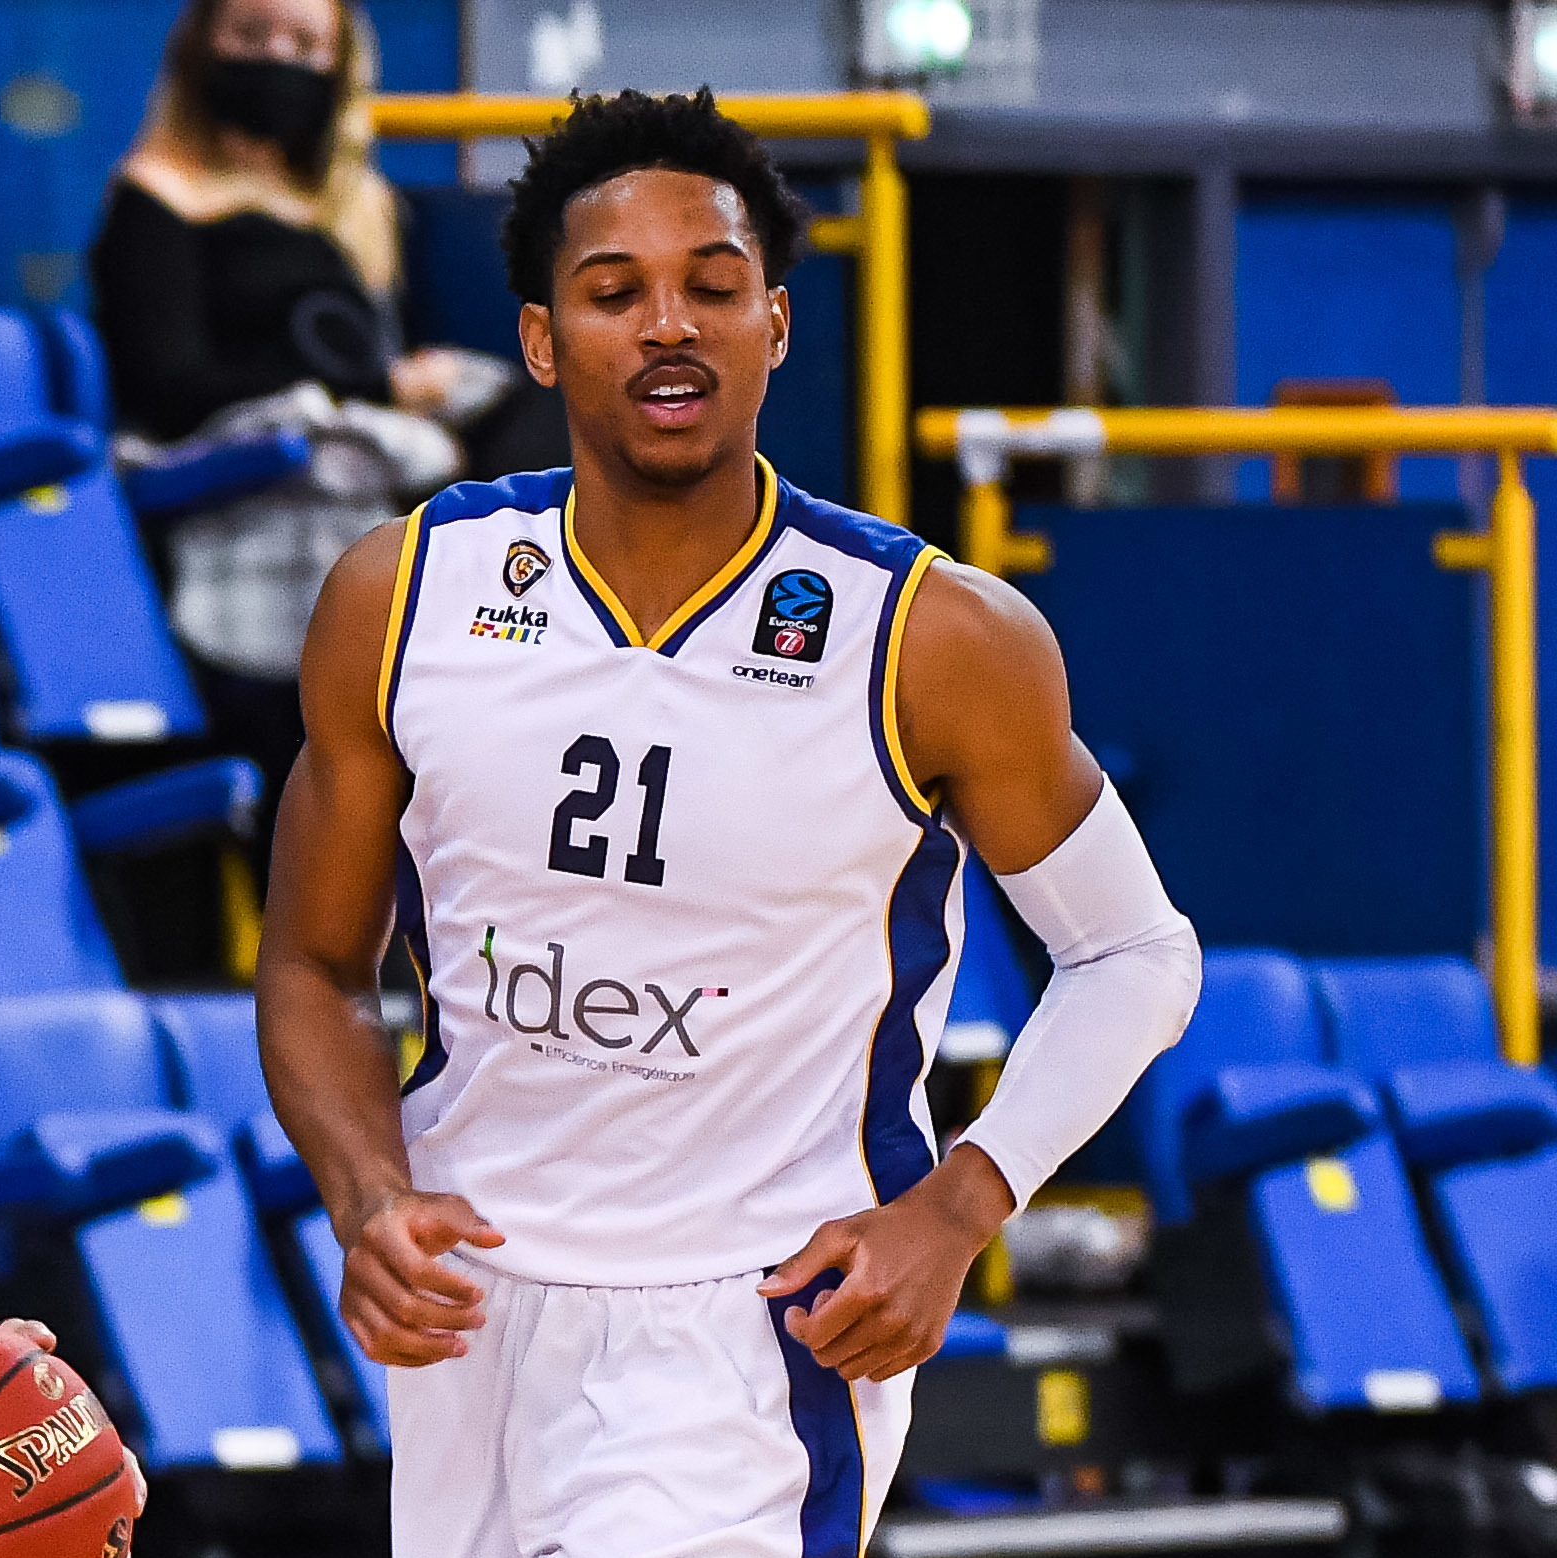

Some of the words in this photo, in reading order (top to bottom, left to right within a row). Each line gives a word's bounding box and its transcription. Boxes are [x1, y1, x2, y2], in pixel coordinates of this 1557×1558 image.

[476, 605, 548, 628] rukka
[769, 616, 819, 632] EuroCup
[548, 734, 672, 887] 21
